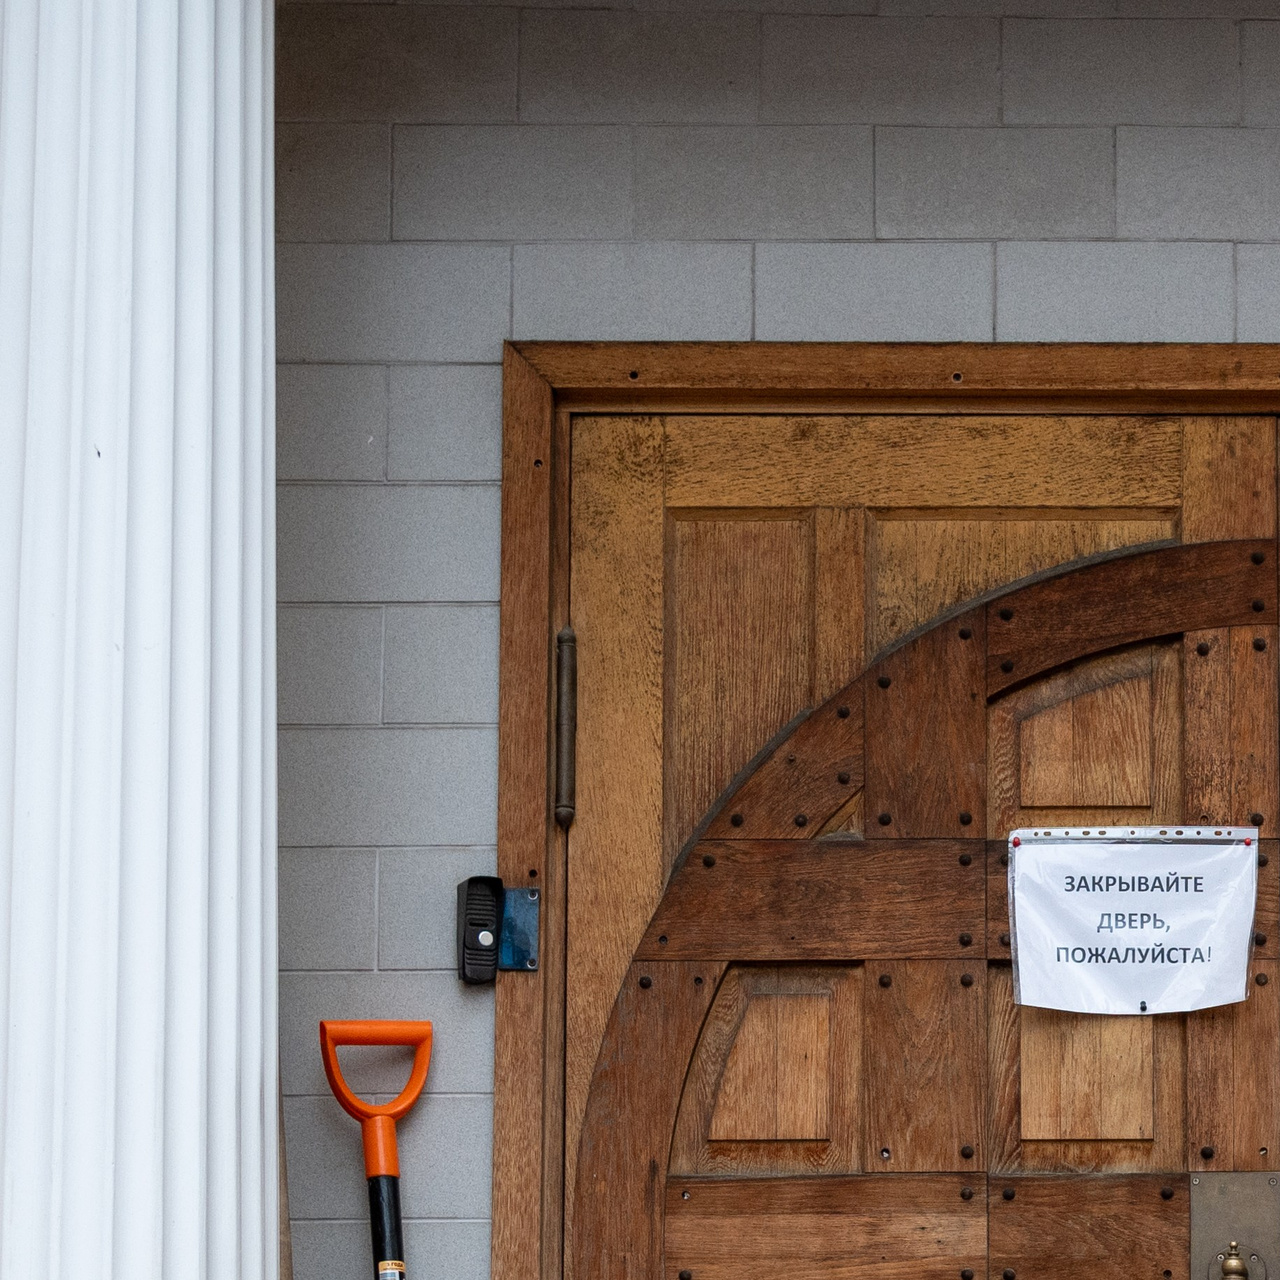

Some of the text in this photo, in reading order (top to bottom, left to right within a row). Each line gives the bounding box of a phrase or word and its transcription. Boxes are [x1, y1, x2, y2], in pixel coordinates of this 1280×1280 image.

[1064, 872, 1204, 893] ЗАКРЫВАЙТЕ
[1096, 912, 1171, 933] ДВЕРЬ,
[1056, 943, 1212, 964] ПОЖАЛУЙСТА!
